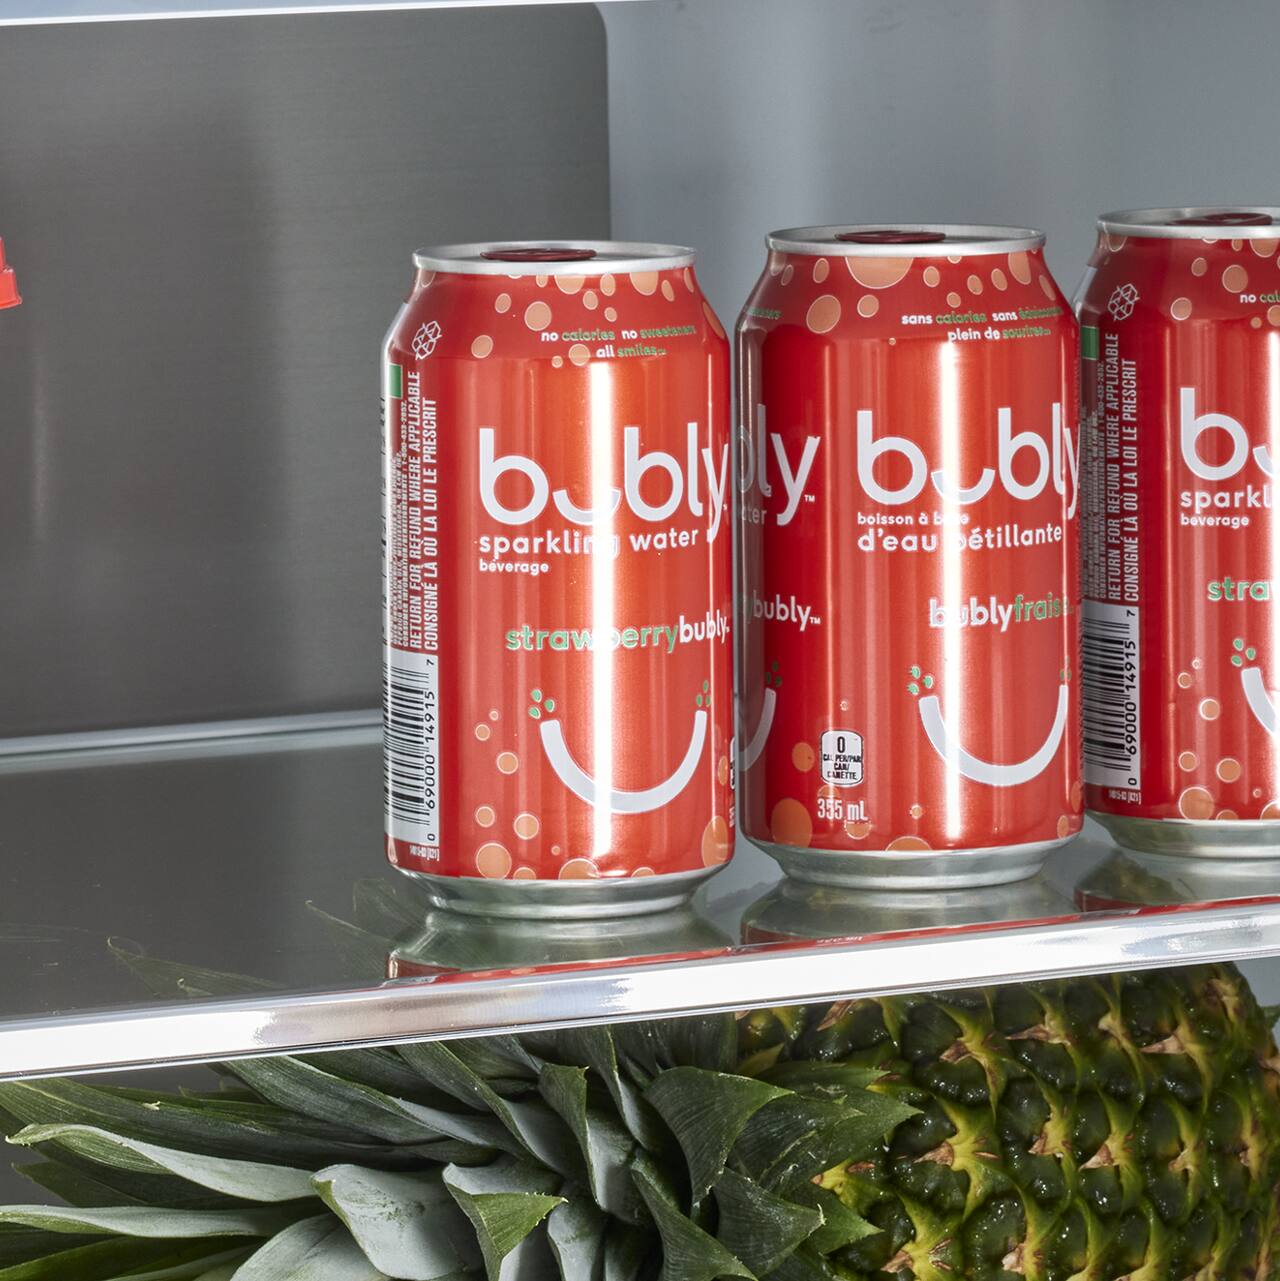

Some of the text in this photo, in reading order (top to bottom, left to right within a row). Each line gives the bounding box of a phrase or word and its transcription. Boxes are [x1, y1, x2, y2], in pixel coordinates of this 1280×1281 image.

[1239, 293, 1257, 304] no
[901, 313, 933, 325] sans
[935, 310, 988, 324] calories
[991, 311, 1019, 322] sans
[540, 327, 638, 342] no calories no
[947, 326, 1001, 343] plein de
[595, 344, 616, 359] all
[857, 402, 1081, 520] bubly
[1105, 332, 1121, 601] RETURN FOR REFUND WHERE APPLICABLE
[479, 422, 729, 545] bubly
[1120, 357, 1138, 602] CONSIGNÉ LÀ OÙ LA LOI LE PRESCRIT
[407, 370, 422, 650] RETURN FOR REFUND WHERE APPLICABLE
[857, 511, 929, 526] boisson à
[1180, 512, 1250, 529] beverage
[420, 397, 438, 650] CONSIGNÉ LÀ OÙ LA LOI LE PRESCRIT
[629, 528, 699, 552] water
[857, 529, 937, 553] d'eau
[479, 557, 549, 577] beverage
[1124, 640, 1137, 756] 69000 14915
[424, 690, 436, 809] 69000 14915
[837, 736, 846, 754] 0
[817, 798, 868, 820] 355 mL
